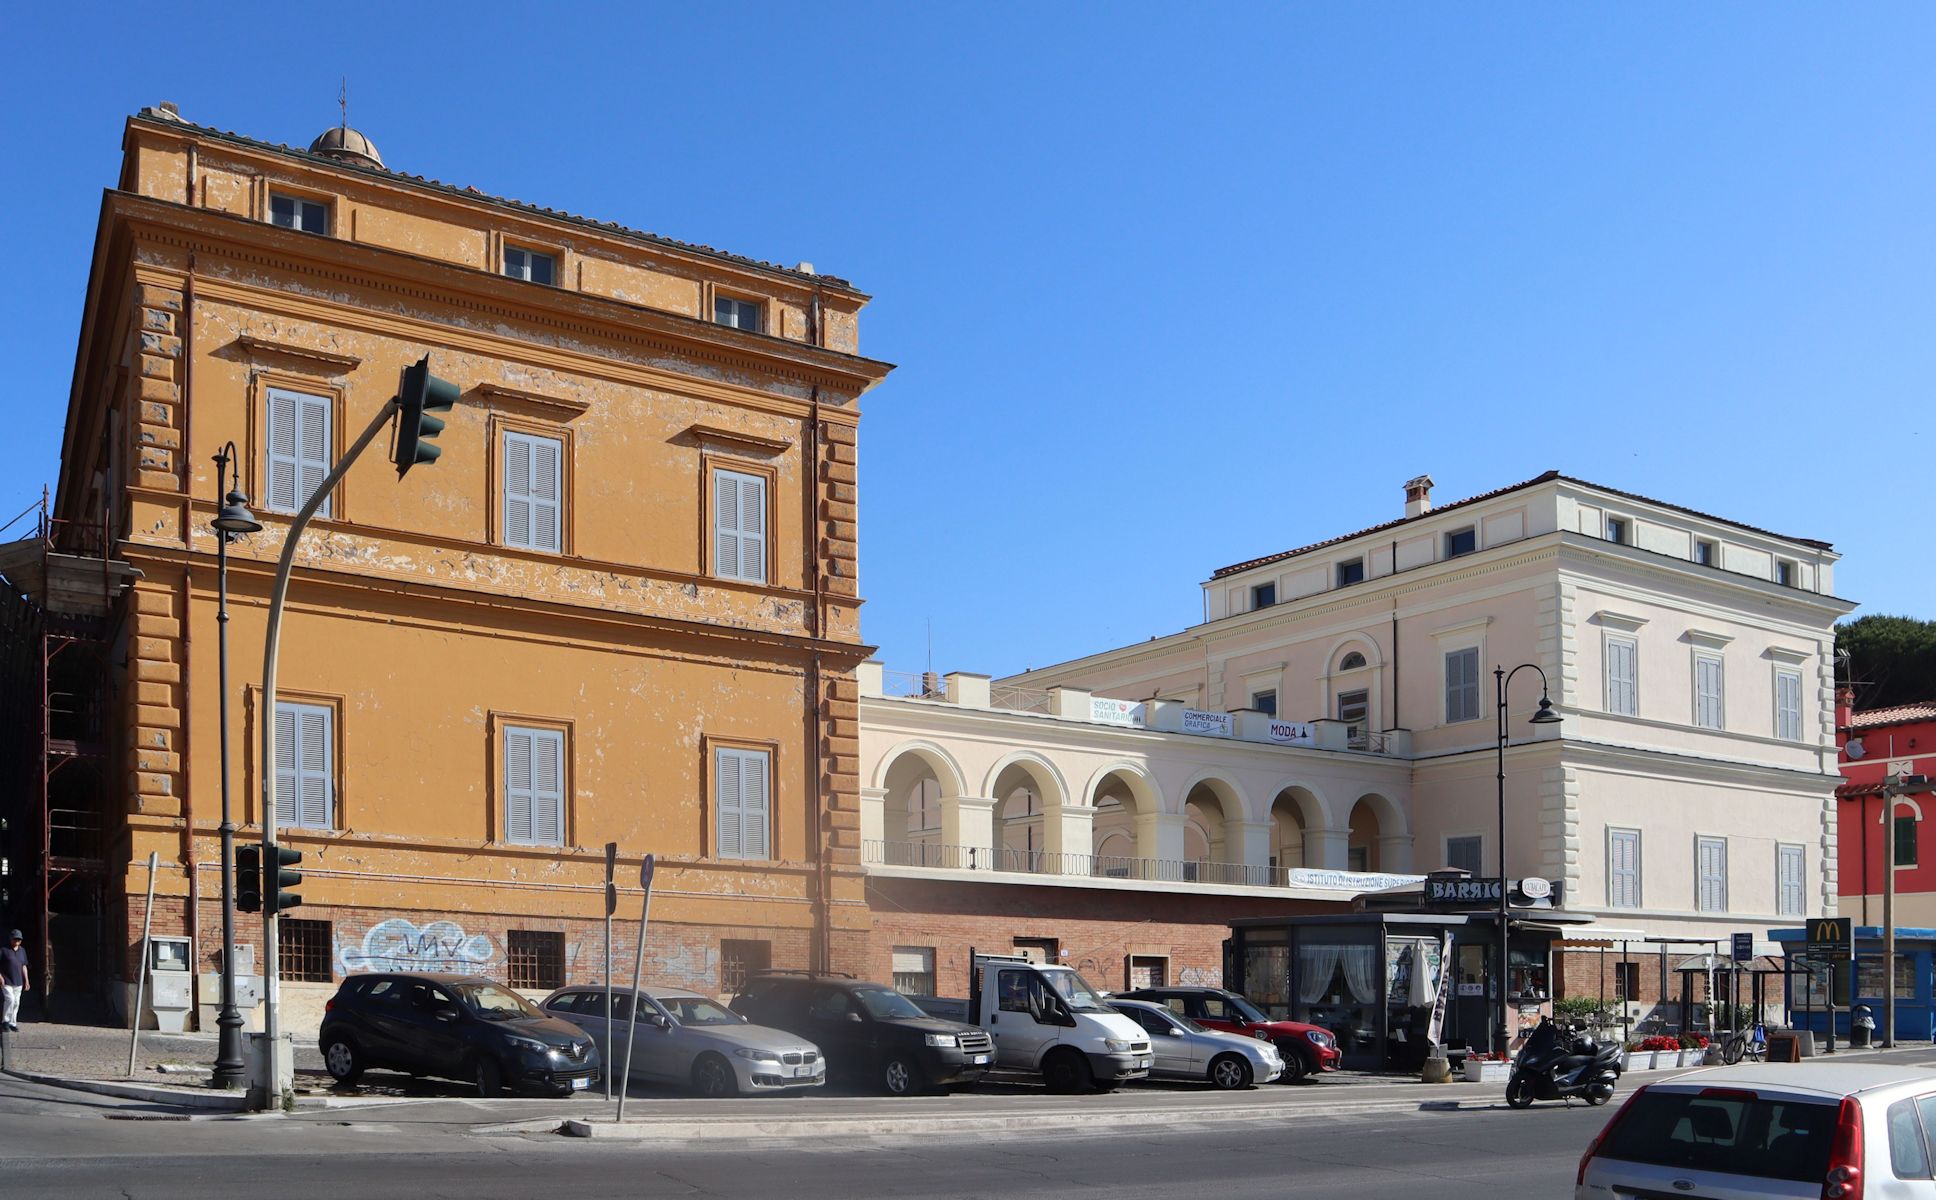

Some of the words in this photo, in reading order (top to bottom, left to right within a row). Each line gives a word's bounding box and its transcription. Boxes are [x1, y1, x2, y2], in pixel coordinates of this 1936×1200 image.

[1094, 701, 1116, 711] SOCIO
[1093, 710, 1134, 721] SANITARIO
[1184, 712, 1226, 723] COMMERCIALE
[1184, 721, 1211, 729] GRAFICA
[1270, 724, 1297, 738] MODA
[1306, 873, 1338, 885] ISTITUTO
